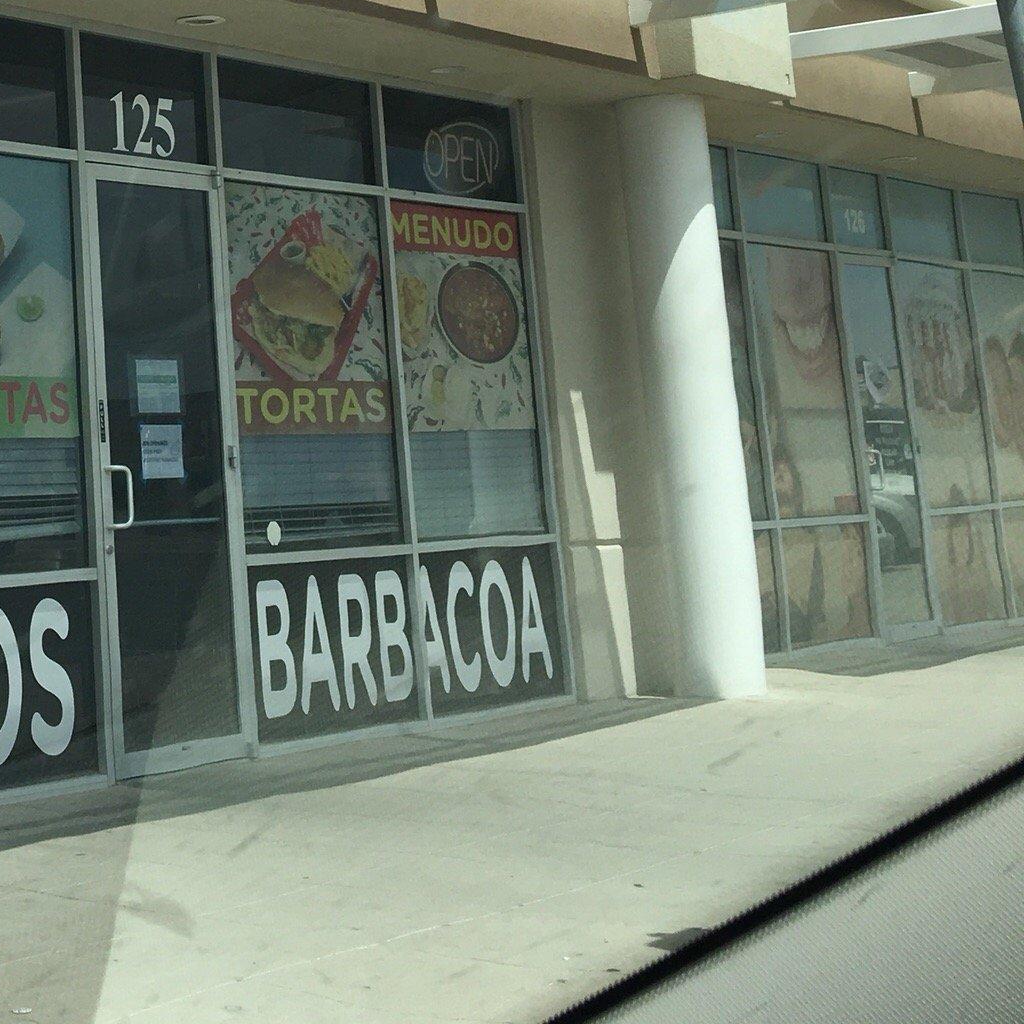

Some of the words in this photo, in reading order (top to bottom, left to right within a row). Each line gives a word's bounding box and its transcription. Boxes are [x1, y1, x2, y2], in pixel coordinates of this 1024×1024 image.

[110, 91, 175, 157] 125
[424, 129, 493, 184] OPEN
[390, 212, 514, 252] MENUDO
[236, 386, 388, 425] TORTAS
[256, 556, 554, 719] BARBACOA
